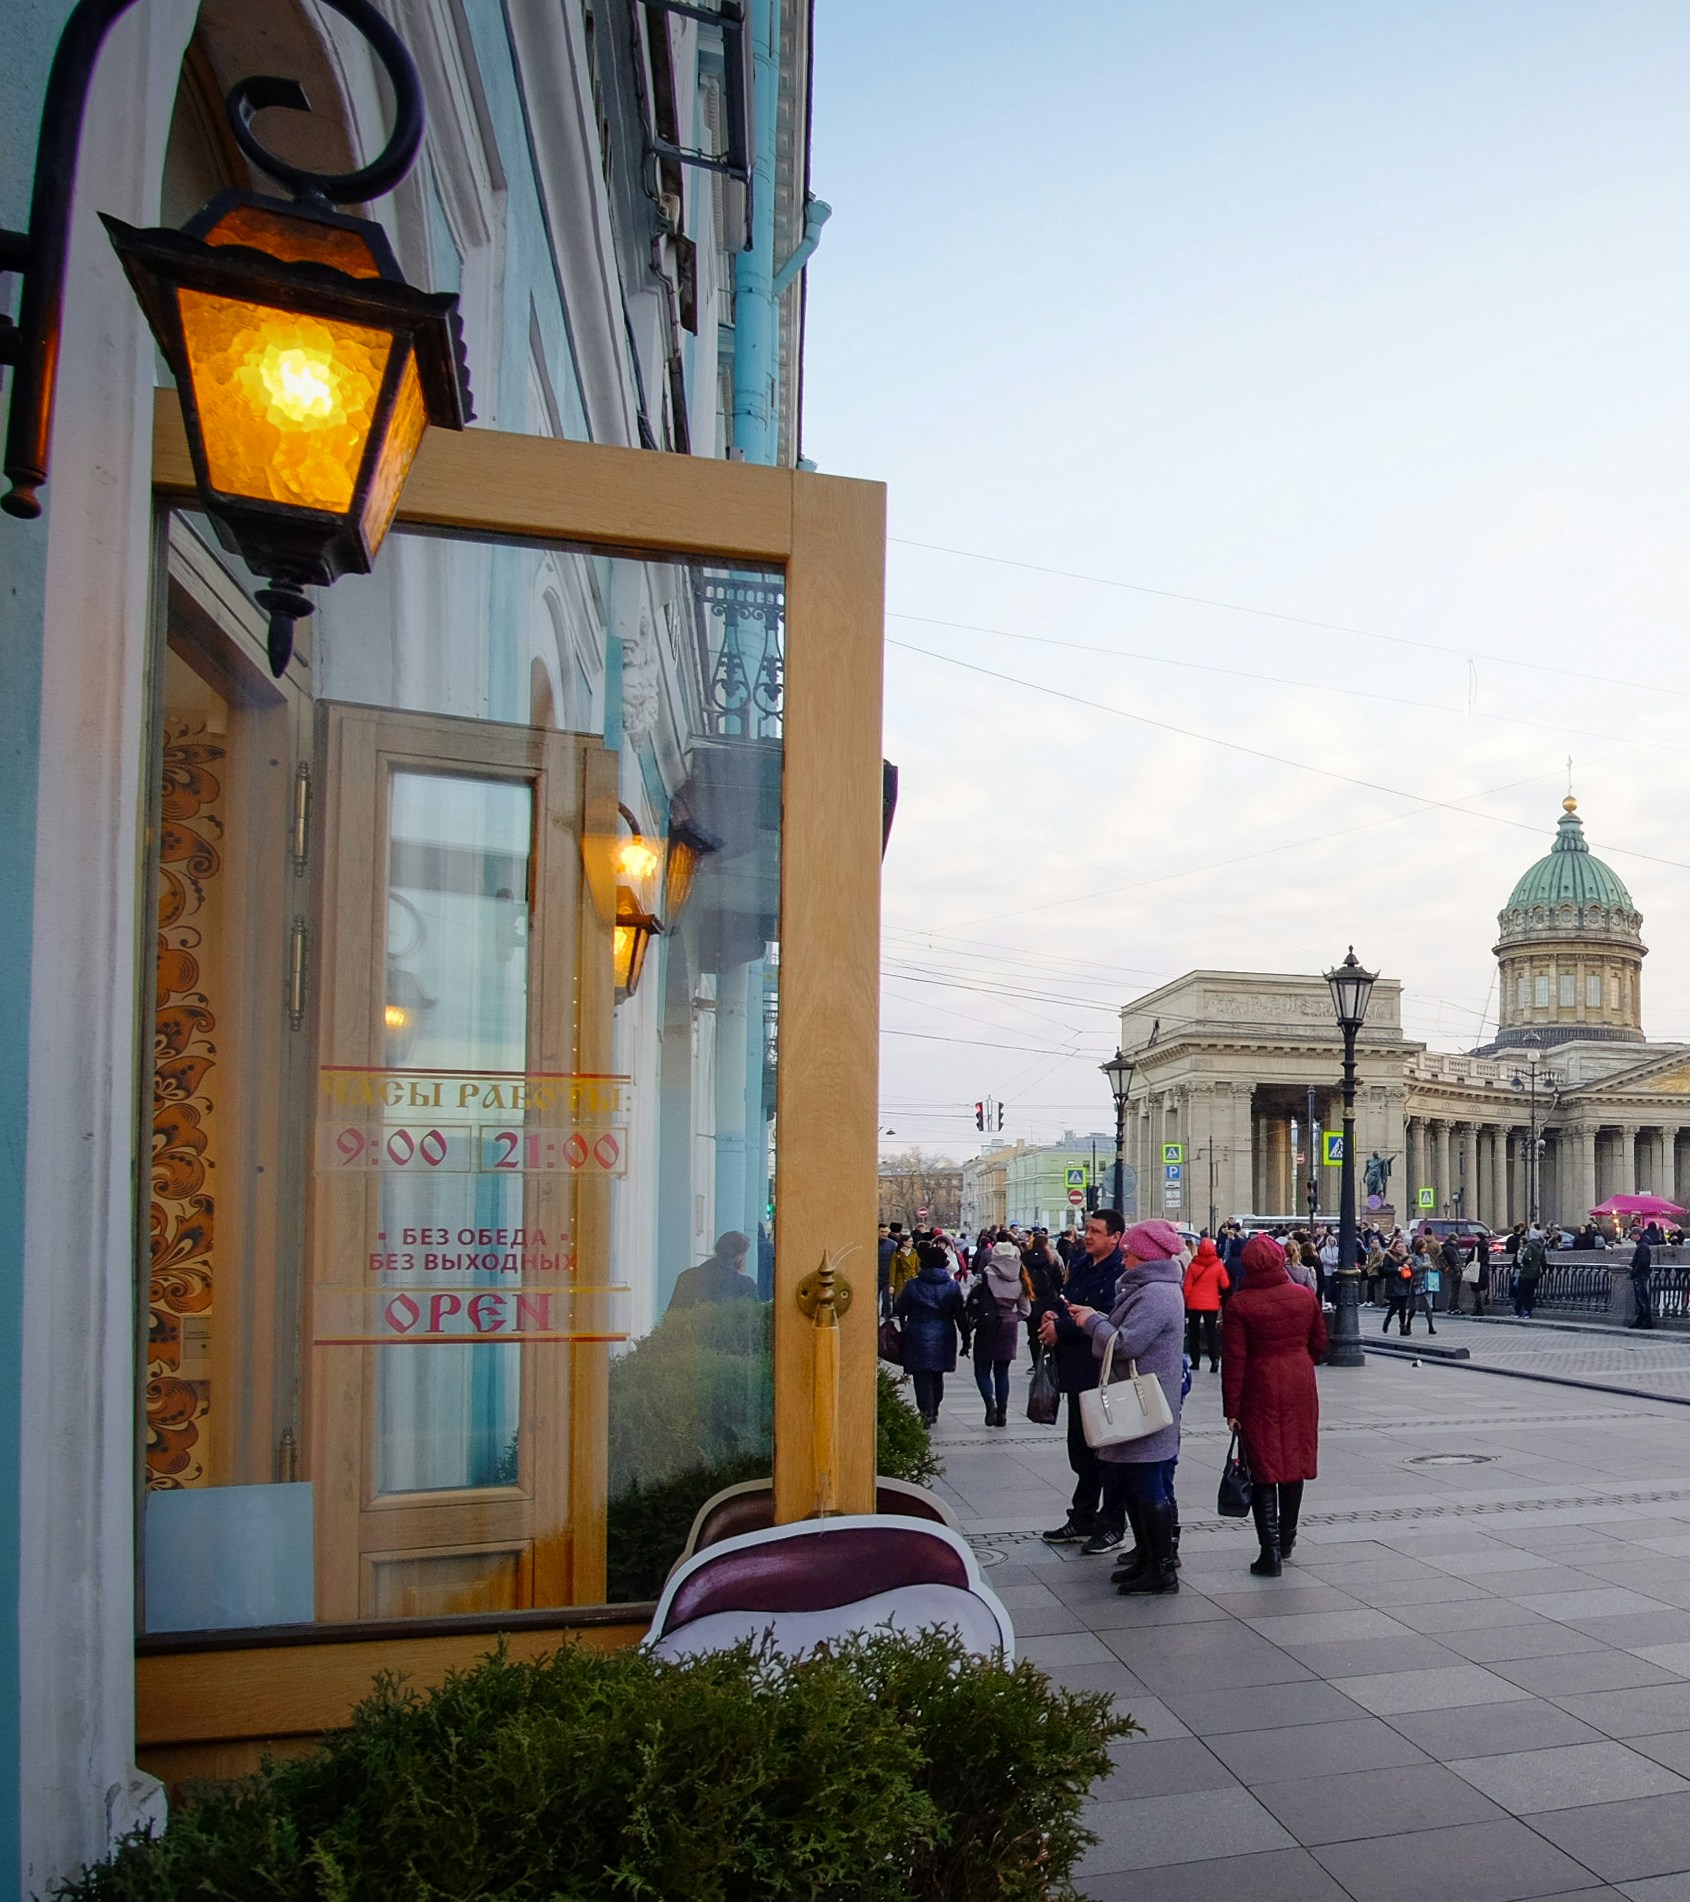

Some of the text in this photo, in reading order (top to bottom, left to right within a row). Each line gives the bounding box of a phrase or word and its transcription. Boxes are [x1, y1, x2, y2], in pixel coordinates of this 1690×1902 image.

[321, 1078, 444, 1109] ЧАСЫ
[335, 1126, 621, 1170] 9:00 21:00
[402, 1227, 548, 1250] БЕЗ ОБЕДА
[368, 1252, 577, 1275] БЕЗ ВЫХОДНЫХ
[384, 1292, 555, 1334] OPEN
